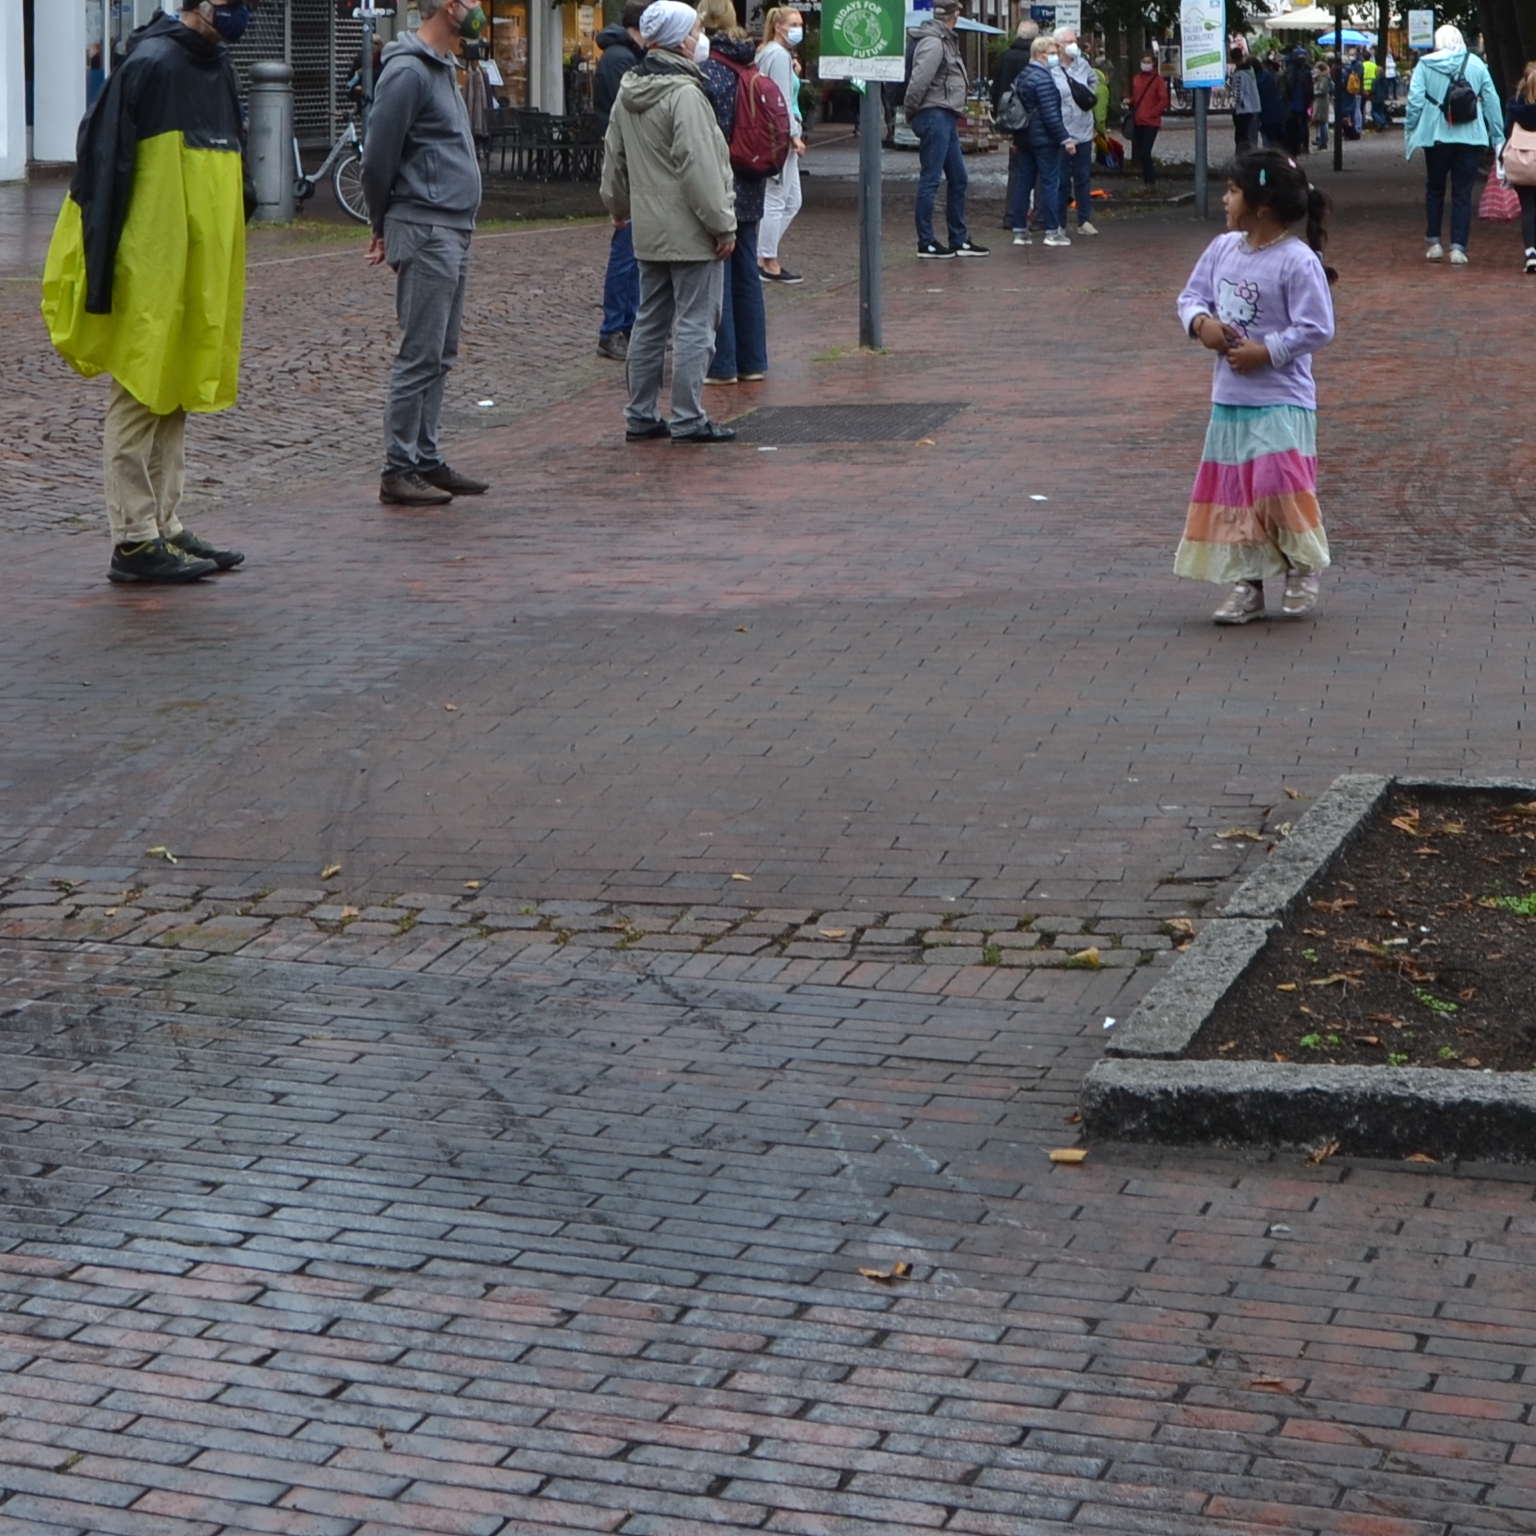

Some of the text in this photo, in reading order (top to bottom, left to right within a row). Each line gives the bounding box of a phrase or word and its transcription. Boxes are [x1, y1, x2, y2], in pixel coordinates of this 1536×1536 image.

[833, 0, 862, 31] FRIDAYS
[863, 0, 882, 16] FOR
[852, 37, 888, 59] FUTURE
